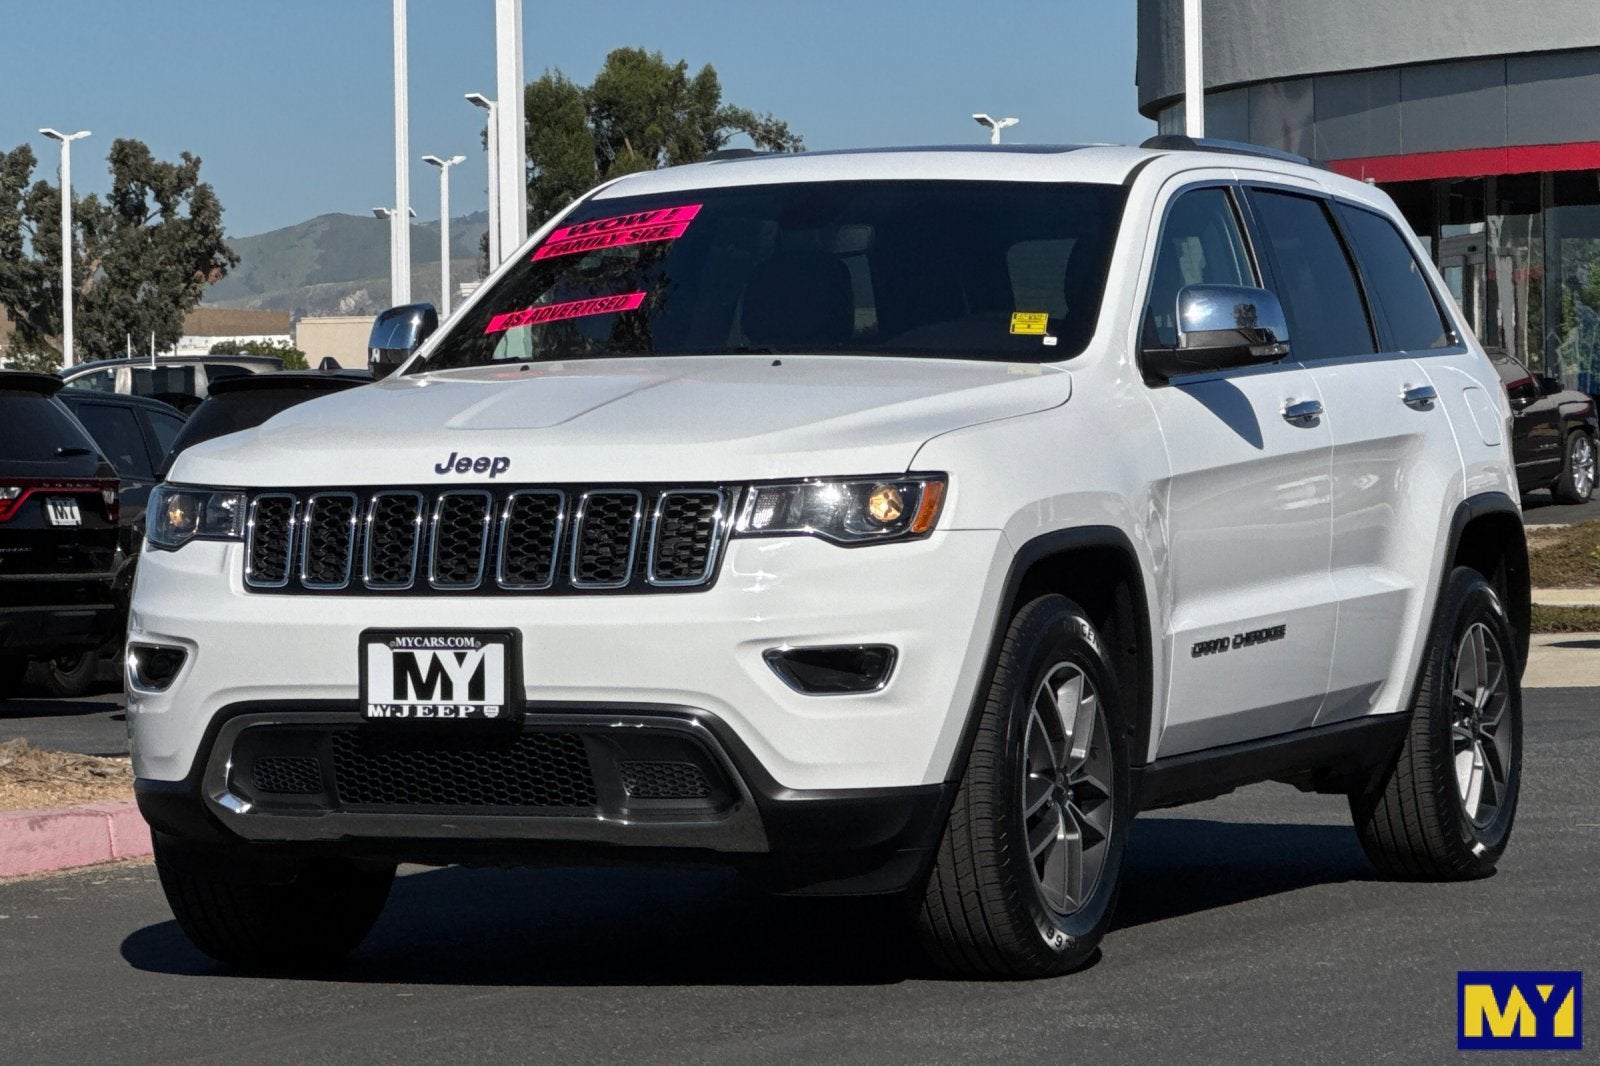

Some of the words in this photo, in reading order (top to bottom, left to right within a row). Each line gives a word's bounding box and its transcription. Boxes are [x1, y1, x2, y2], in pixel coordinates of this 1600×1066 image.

[543, 232, 620, 257] FAMILY
[500, 311, 525, 328] AS
[524, 296, 629, 324] ADVERTISED
[434, 452, 510, 478] Jeep
[395, 636, 475, 648] MYCARS.COM
[1191, 637, 1230, 656] GRAND
[1231, 624, 1286, 649] CHEROKEE
[393, 652, 485, 701] MY
